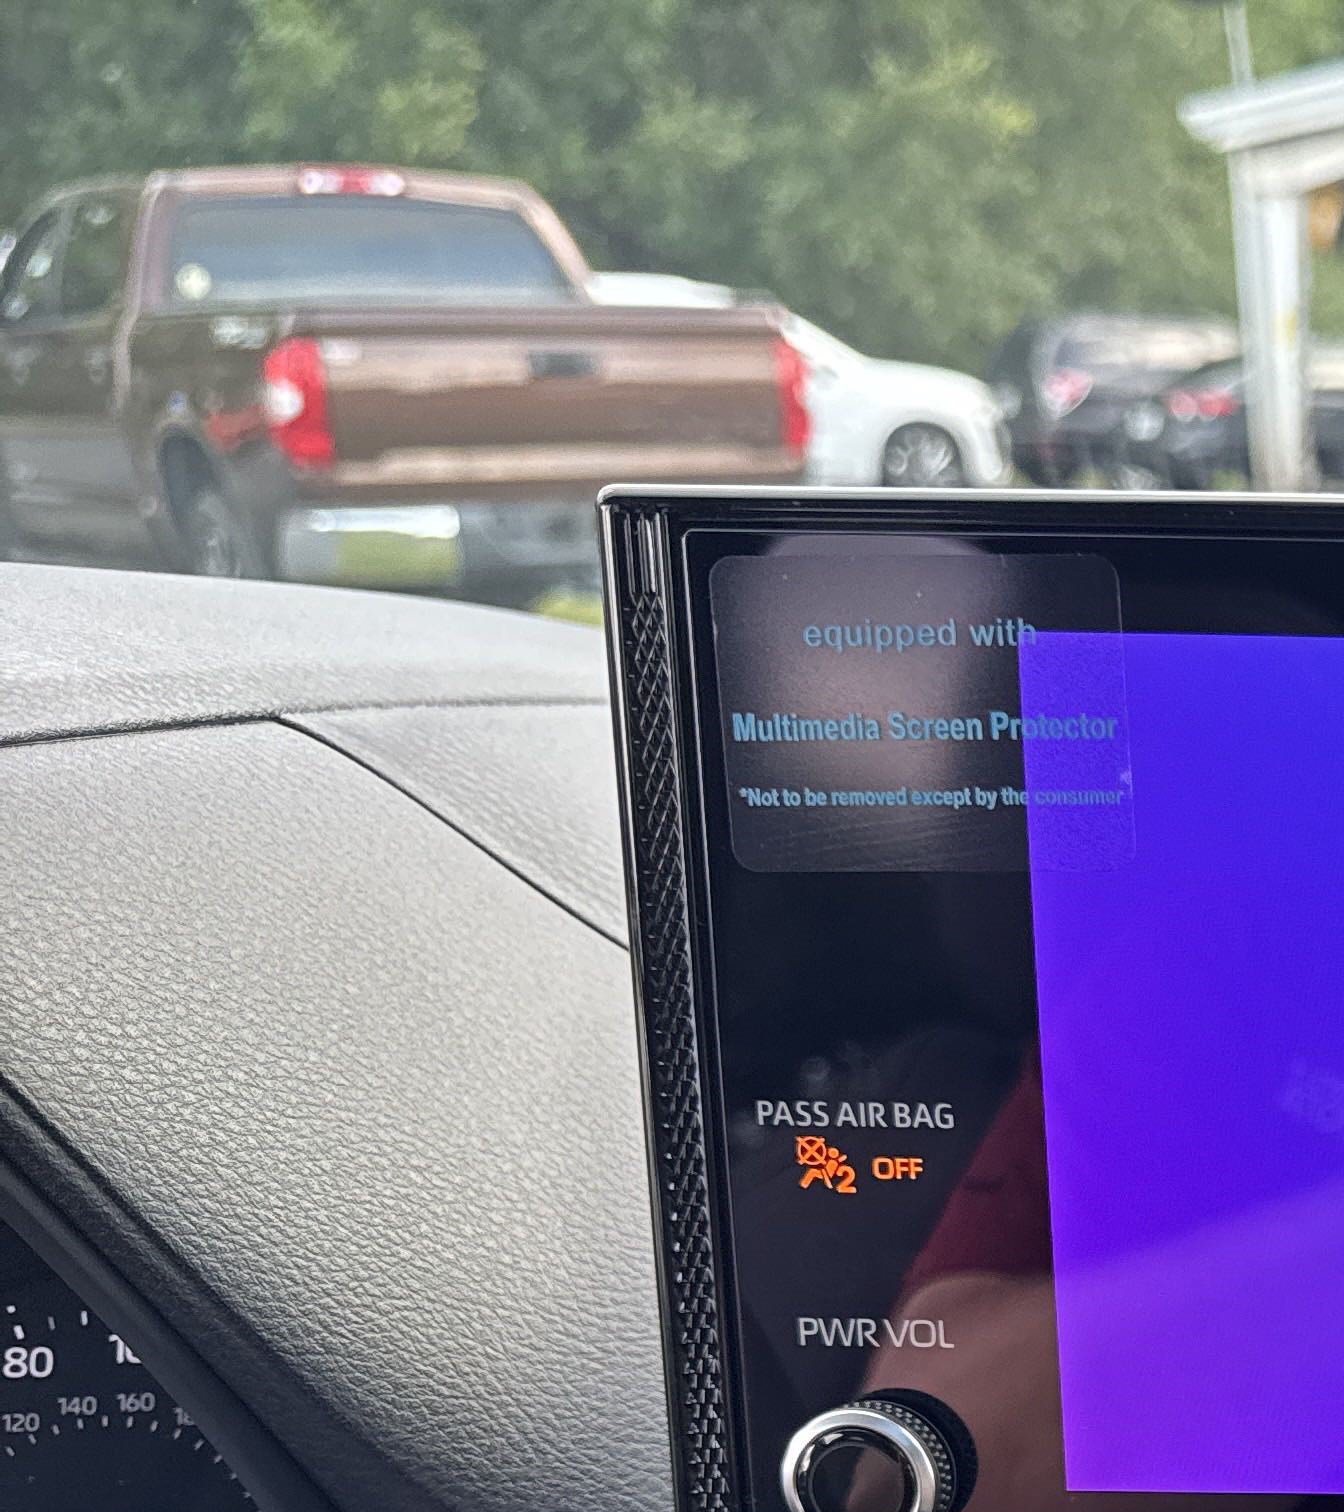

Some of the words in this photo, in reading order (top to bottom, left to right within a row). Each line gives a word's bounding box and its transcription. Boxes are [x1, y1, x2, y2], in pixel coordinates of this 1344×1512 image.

[803, 618, 956, 653] equipped
[969, 617, 1037, 647] with
[731, 712, 880, 741] Multimedia
[888, 711, 983, 741] Screen
[990, 711, 1117, 741] Protector
[782, 788, 801, 807] to
[803, 786, 827, 807] be
[832, 787, 907, 807] removed
[912, 788, 970, 810] except
[975, 788, 998, 811] by
[1001, 786, 1029, 806] the
[757, 1100, 829, 1127] PASS
[837, 1102, 888, 1127] AIR
[894, 1103, 954, 1129] BAG
[872, 1157, 923, 1180] OFF
[797, 1317, 880, 1347] PWR
[882, 1319, 955, 1348] VOL
[2, 1347, 54, 1378] 80
[2, 1413, 40, 1432] 120
[57, 1396, 98, 1416] 140
[116, 1392, 156, 1412] 160
